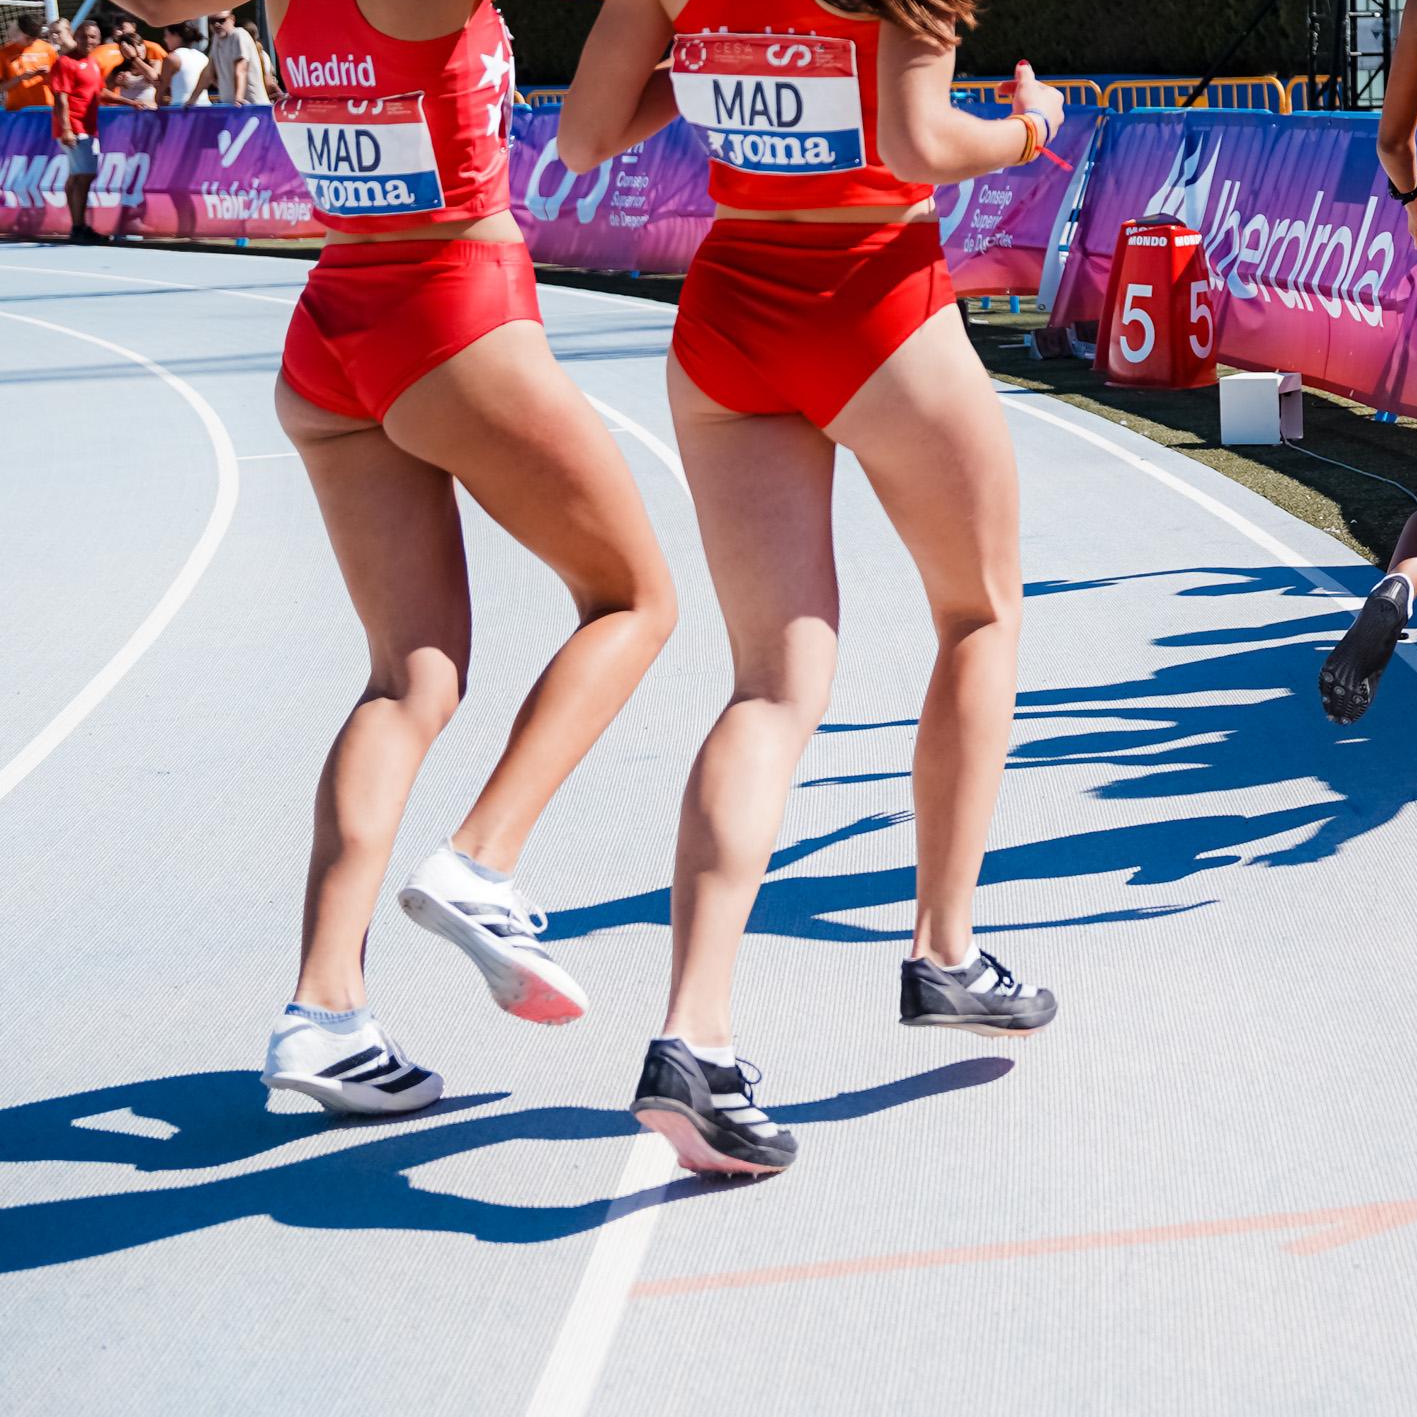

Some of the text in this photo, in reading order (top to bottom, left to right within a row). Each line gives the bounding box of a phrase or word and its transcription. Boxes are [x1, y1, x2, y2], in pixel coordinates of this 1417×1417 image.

[286, 53, 377, 88] Madrid
[712, 79, 804, 128] MAD
[306, 127, 382, 173] MAD
[728, 133, 836, 166] Joma
[1128, 236, 1168, 247] MONDO
[1119, 283, 1155, 364] 5
[1189, 280, 1214, 359] 5
